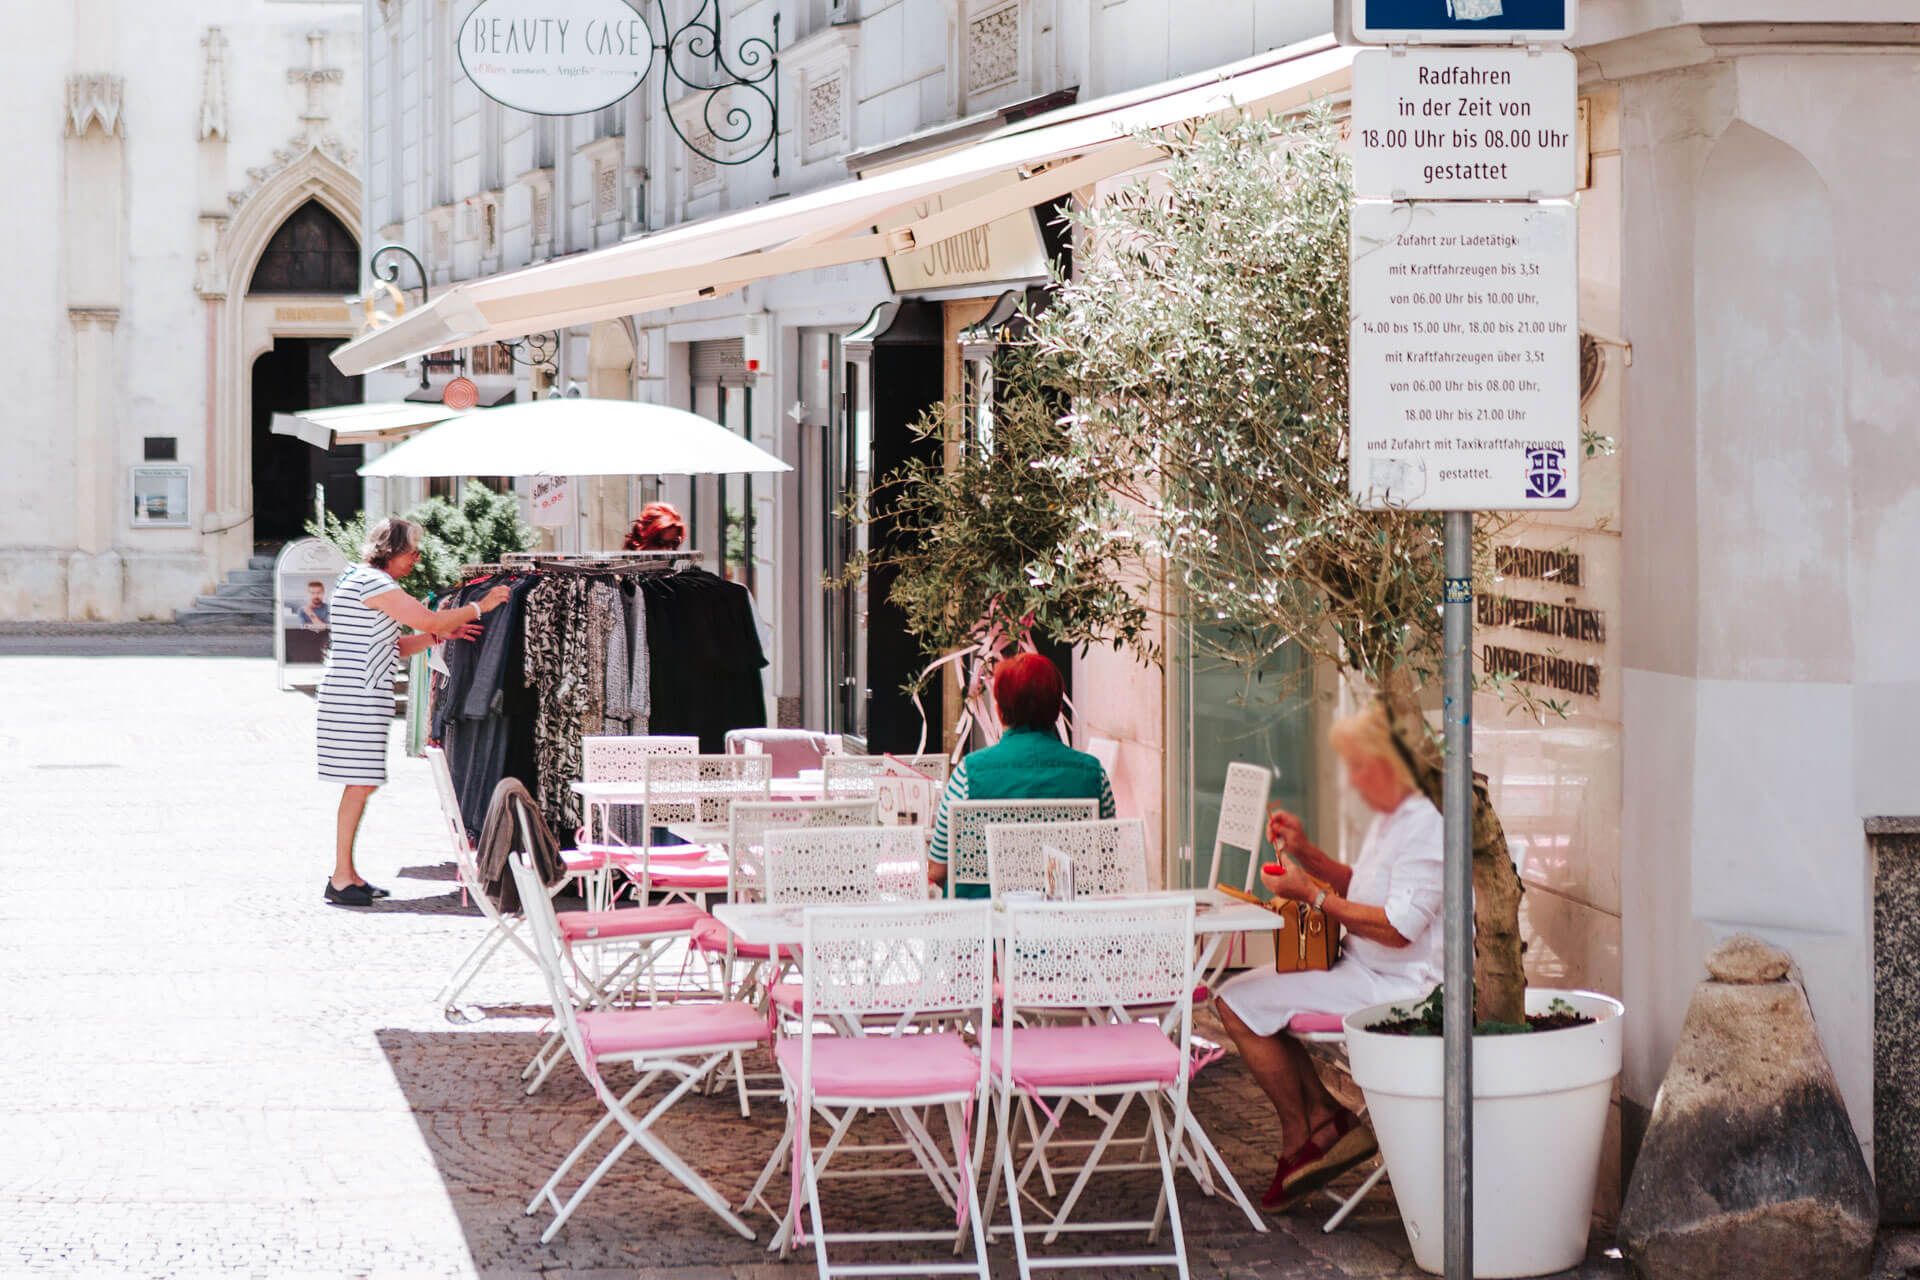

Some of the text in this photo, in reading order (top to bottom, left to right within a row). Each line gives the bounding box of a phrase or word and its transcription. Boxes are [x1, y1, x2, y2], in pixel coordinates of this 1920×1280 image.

[474, 18, 639, 56] BEAUTY CASE
[1418, 66, 1512, 85] Radfahren
[1397, 96, 1531, 117] in der Zeit von
[1361, 128, 1569, 149] 18.00 Uhr bis 08.00 Uhr
[1423, 162, 1508, 184] gestattet
[1396, 232, 1520, 249] Zufahrt zur Ladetätigk
[1388, 262, 1540, 278] mit Kraftfahrzeugen bis 3,5t
[1389, 291, 1540, 307] von 06.00 Uhr bis 10.00 Uhr,
[1362, 320, 1568, 336] 14.00 bis 15.00 Uhr, 18.00 bis 21.00 Uhr
[1384, 350, 1545, 366] mit Kraftfahrzeugen über 3,5t
[1389, 382, 1410, 393] von
[1412, 379, 1442, 393] 06.00
[1444, 379, 1464, 392] Uhr
[1467, 379, 1484, 392] bis
[1485, 379, 1516, 393] 08.00
[1404, 408, 1527, 422] 18.00 Uhr bis 21.00 Uhr
[1367, 437, 1565, 451] und Zufahrt mit Taxikraftfahrzeugen
